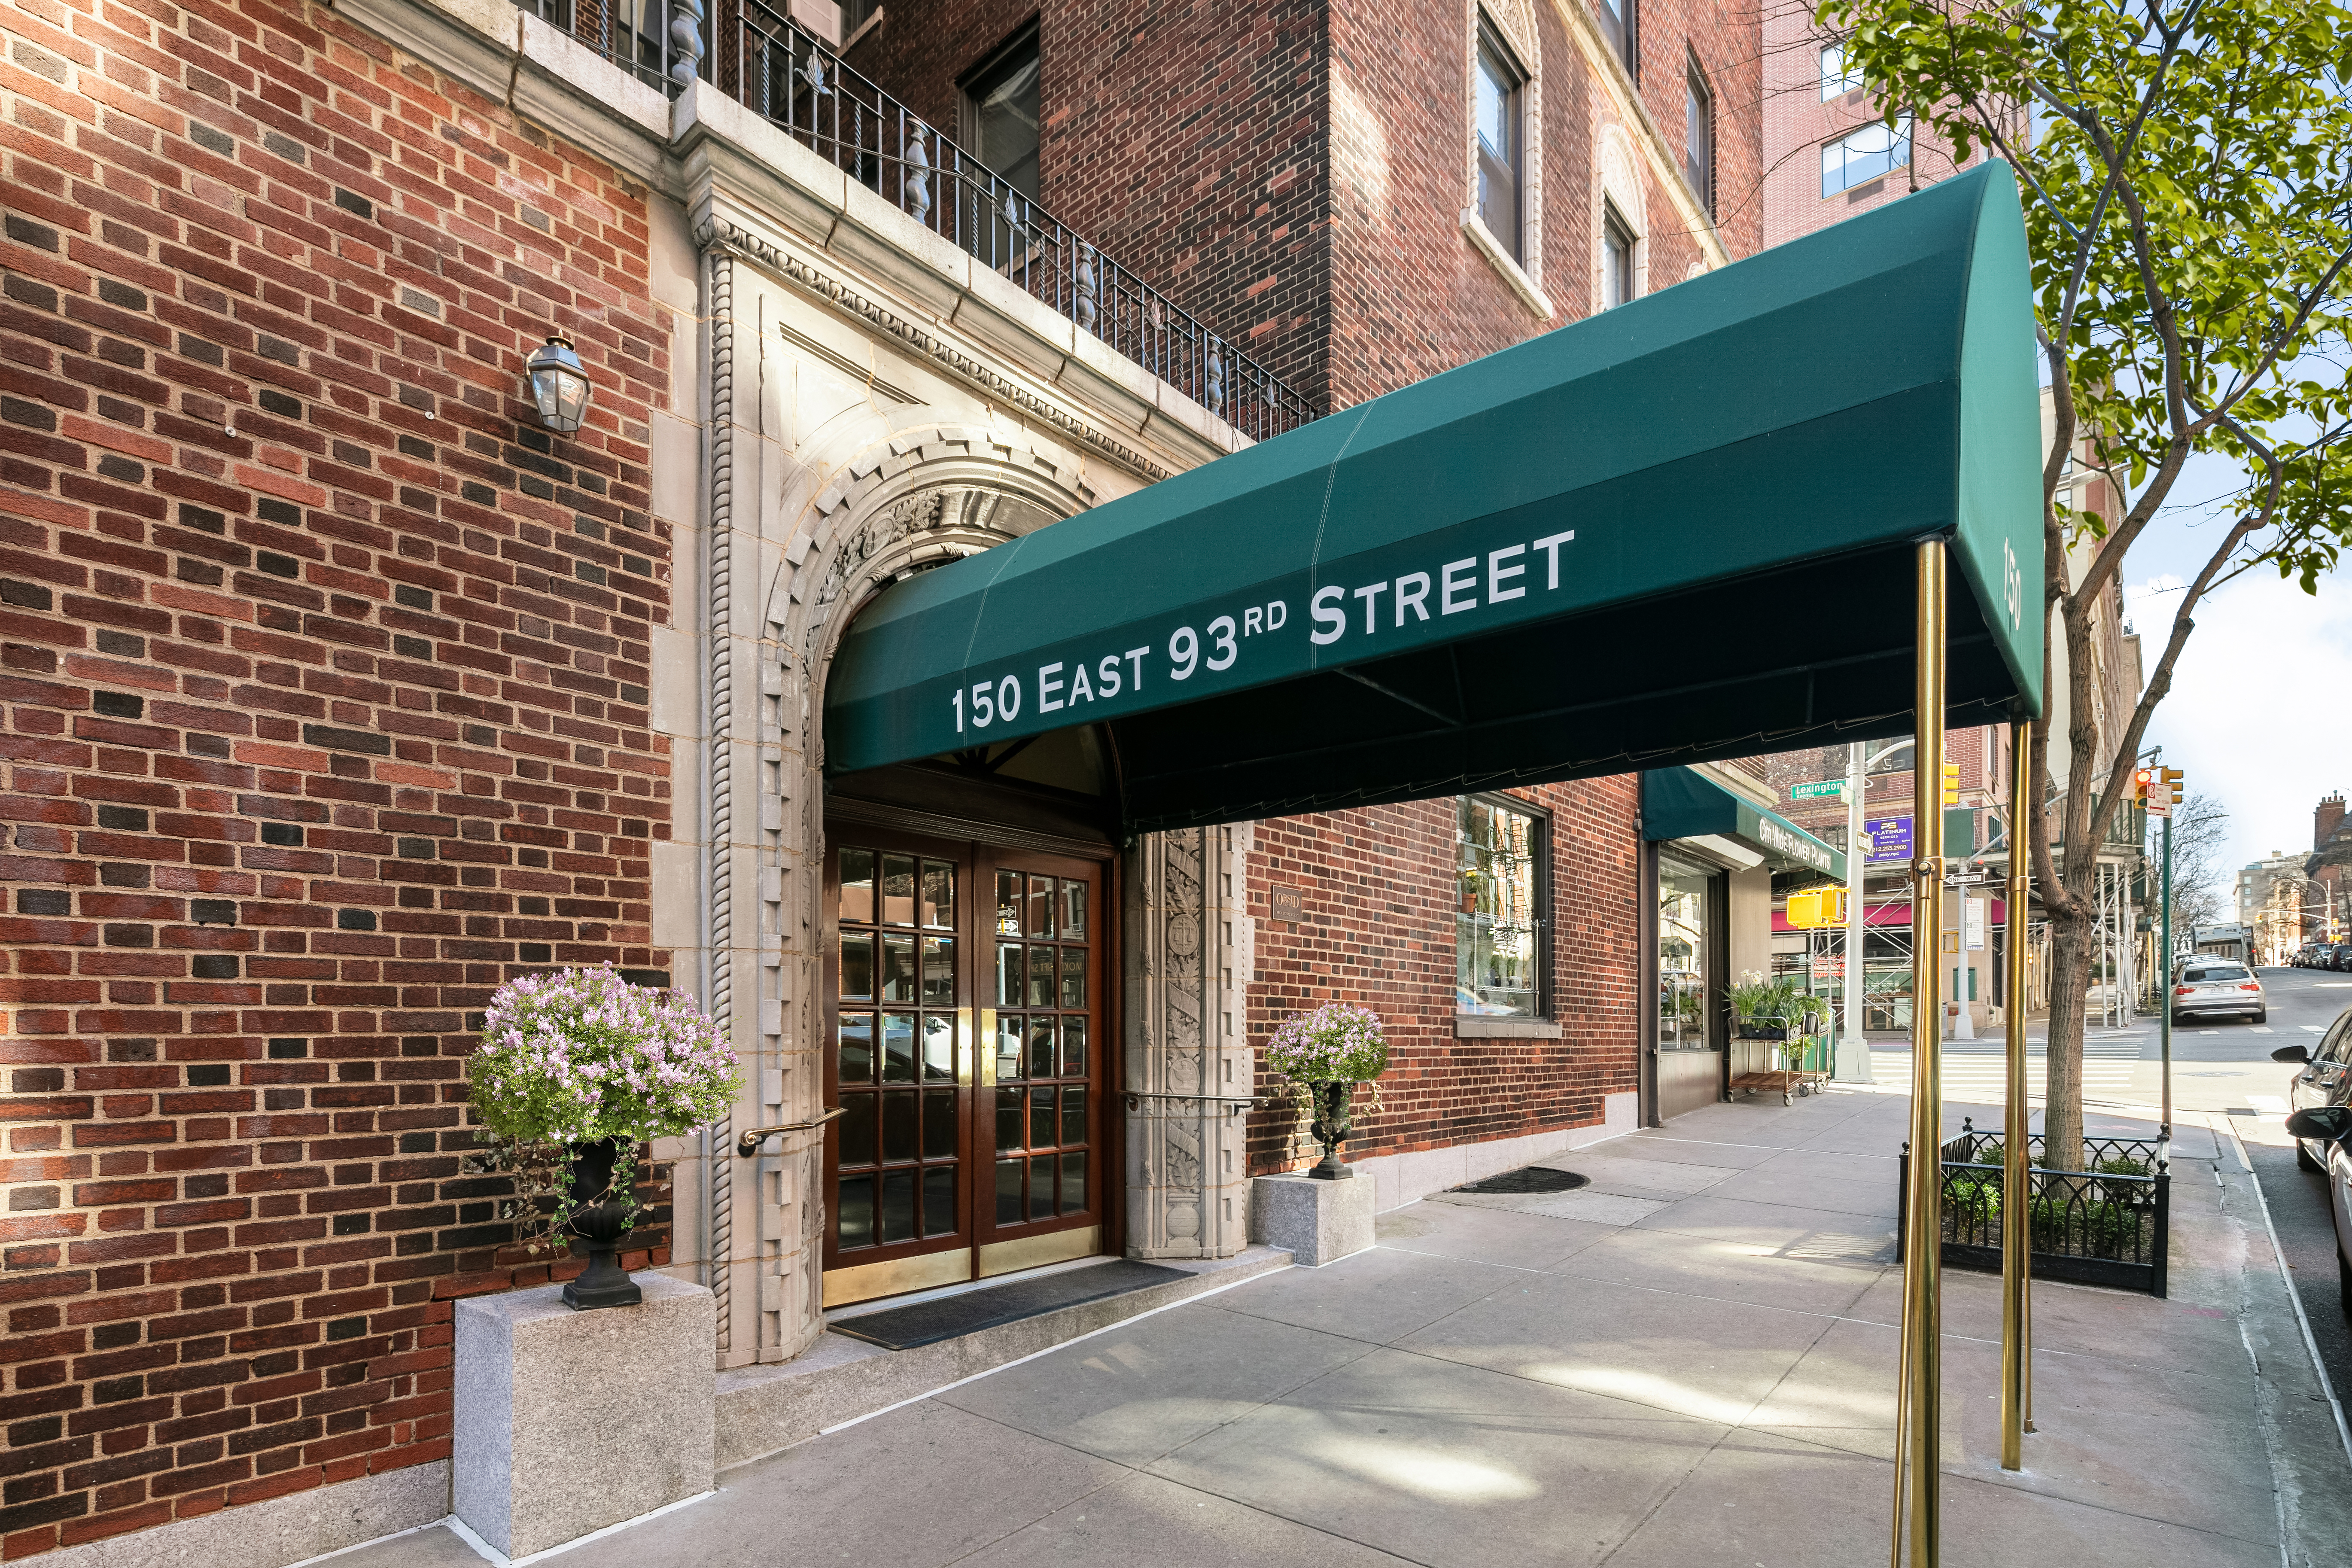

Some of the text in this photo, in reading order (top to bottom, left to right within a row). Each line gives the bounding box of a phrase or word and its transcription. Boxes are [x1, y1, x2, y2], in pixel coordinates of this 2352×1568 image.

[2004, 536, 2021, 631] 150
[952, 674, 1021, 733] 150
[1039, 645, 1150, 713] EAST
[1310, 529, 1575, 645] STREET
[1796, 782, 1842, 794] Lexington
[1811, 844, 1831, 871] PLANTS
[1276, 892, 1299, 908] ORSID
